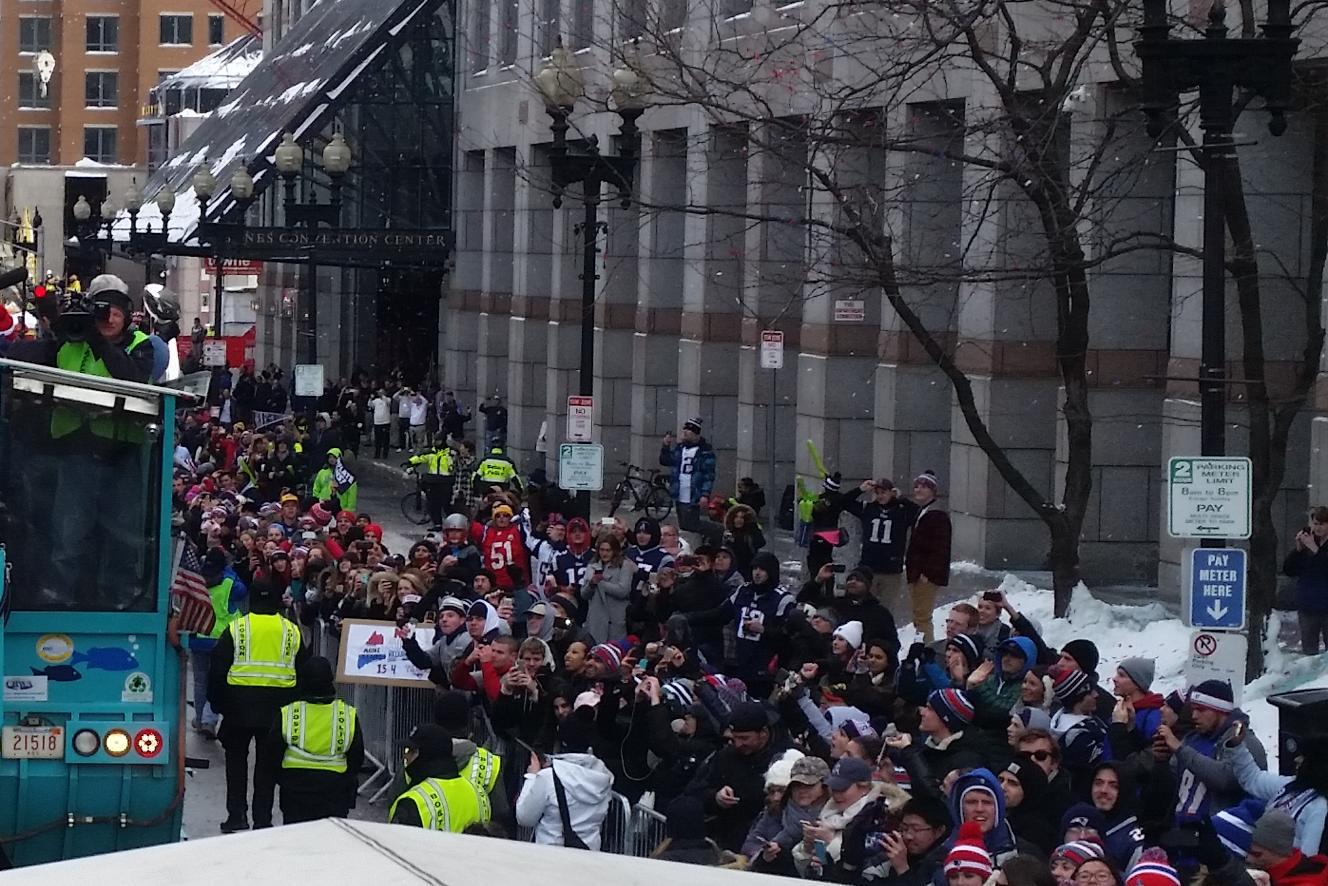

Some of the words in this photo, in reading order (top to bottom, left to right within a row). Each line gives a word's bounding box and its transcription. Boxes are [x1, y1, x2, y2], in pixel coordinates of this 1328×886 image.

[384, 234, 446, 247] CENTER
[1174, 461, 1191, 477] 2
[1196, 504, 1224, 513] PAY
[870, 518, 893, 544] 11
[490, 540, 514, 571] 51
[1207, 554, 1229, 567] PAY
[1199, 569, 1238, 582] METER
[1203, 585, 1233, 597] HERE
[336, 710, 345, 752] POLICE
[13, 734, 57, 751] 21518
